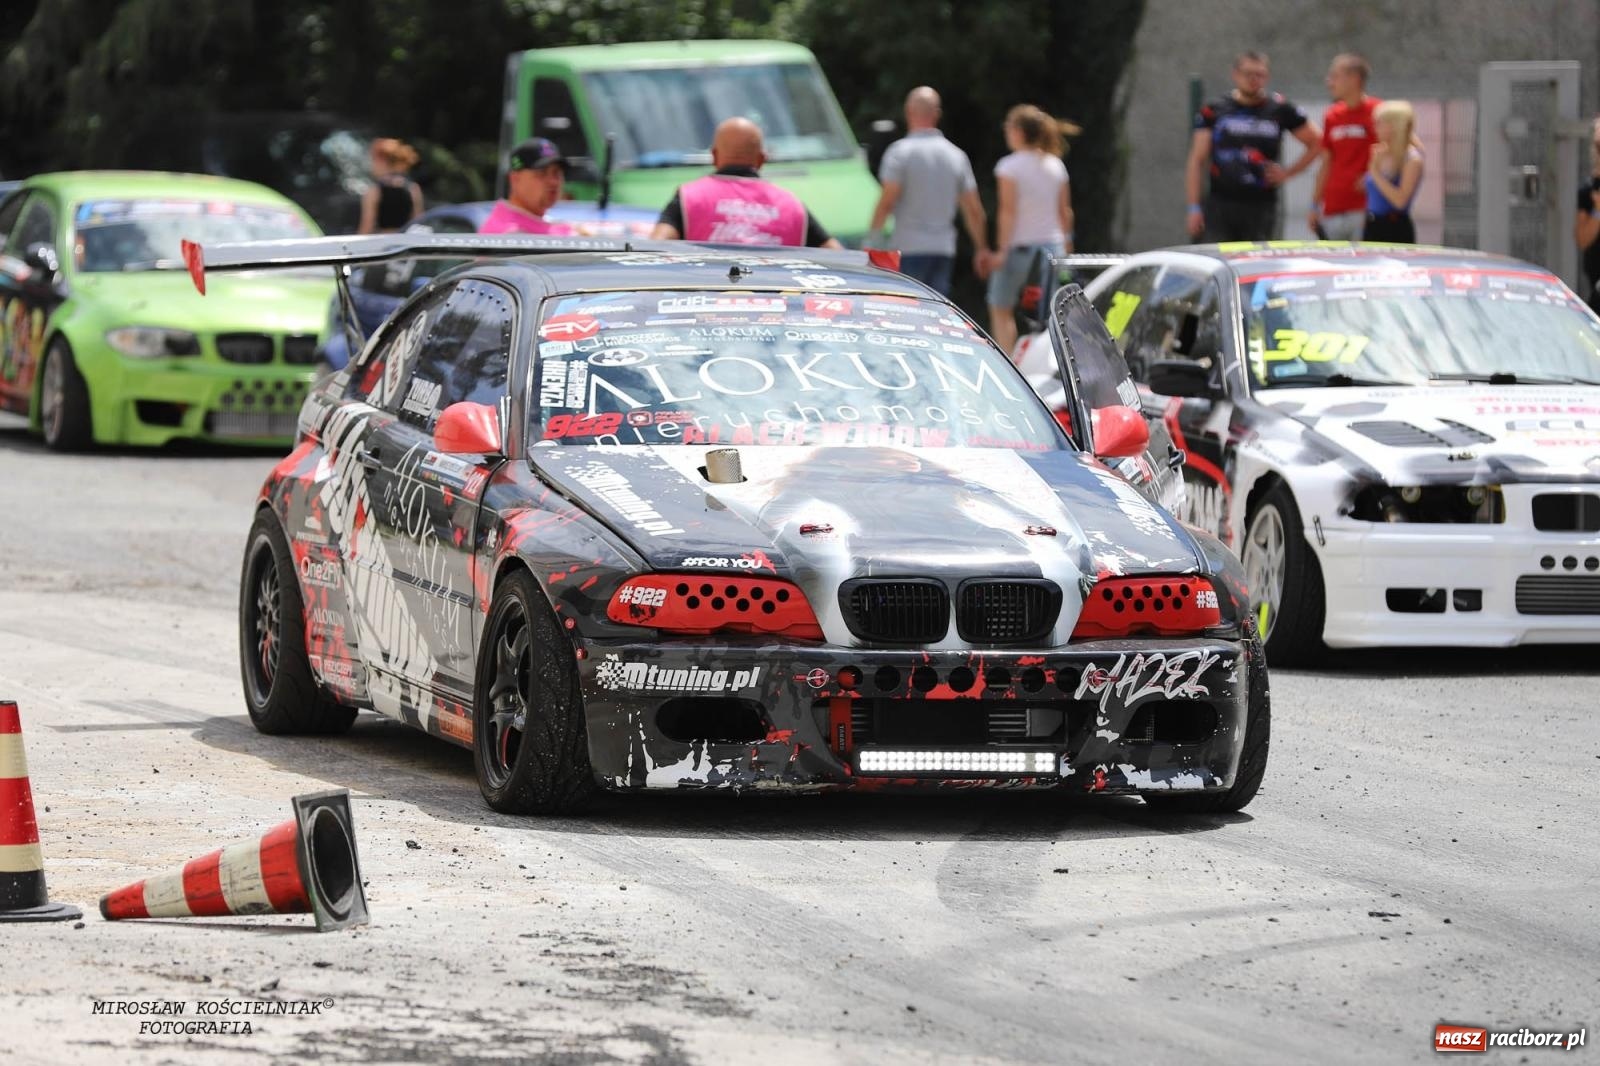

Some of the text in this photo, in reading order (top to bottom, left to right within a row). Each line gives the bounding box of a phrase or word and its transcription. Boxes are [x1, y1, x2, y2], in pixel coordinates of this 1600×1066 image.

[814, 300, 843, 311] 74
[1263, 329, 1370, 363] 301
[581, 352, 1022, 421] ALOKUM
[544, 412, 624, 439] 922
[594, 400, 1036, 446] nieruchomości
[682, 557, 729, 568] #FOR
[619, 586, 667, 607] #922
